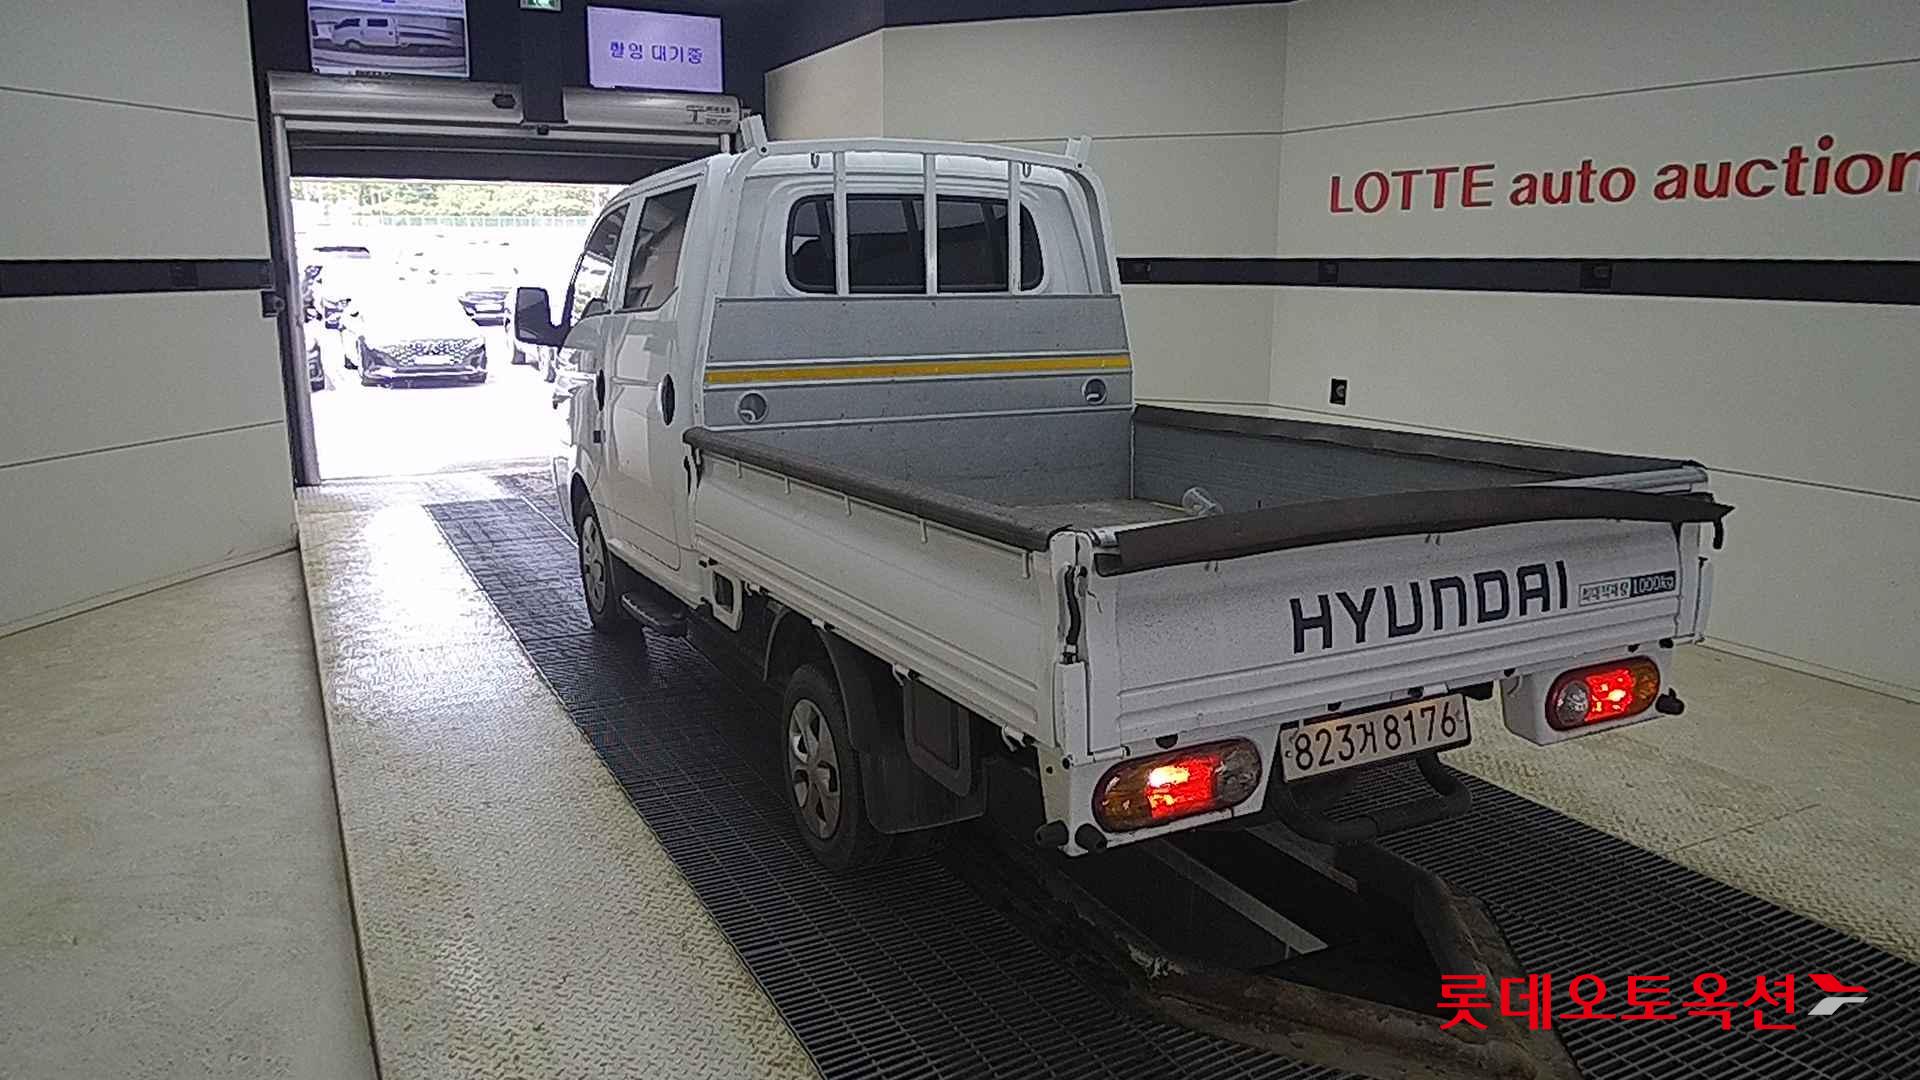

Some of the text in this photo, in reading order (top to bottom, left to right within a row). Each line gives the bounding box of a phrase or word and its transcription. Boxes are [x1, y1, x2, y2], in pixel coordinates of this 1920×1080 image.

[651, 44, 703, 65] 대기중
[1329, 134, 1920, 214] LOTTE auto auction
[1289, 559, 1569, 655] HYUNDAI
